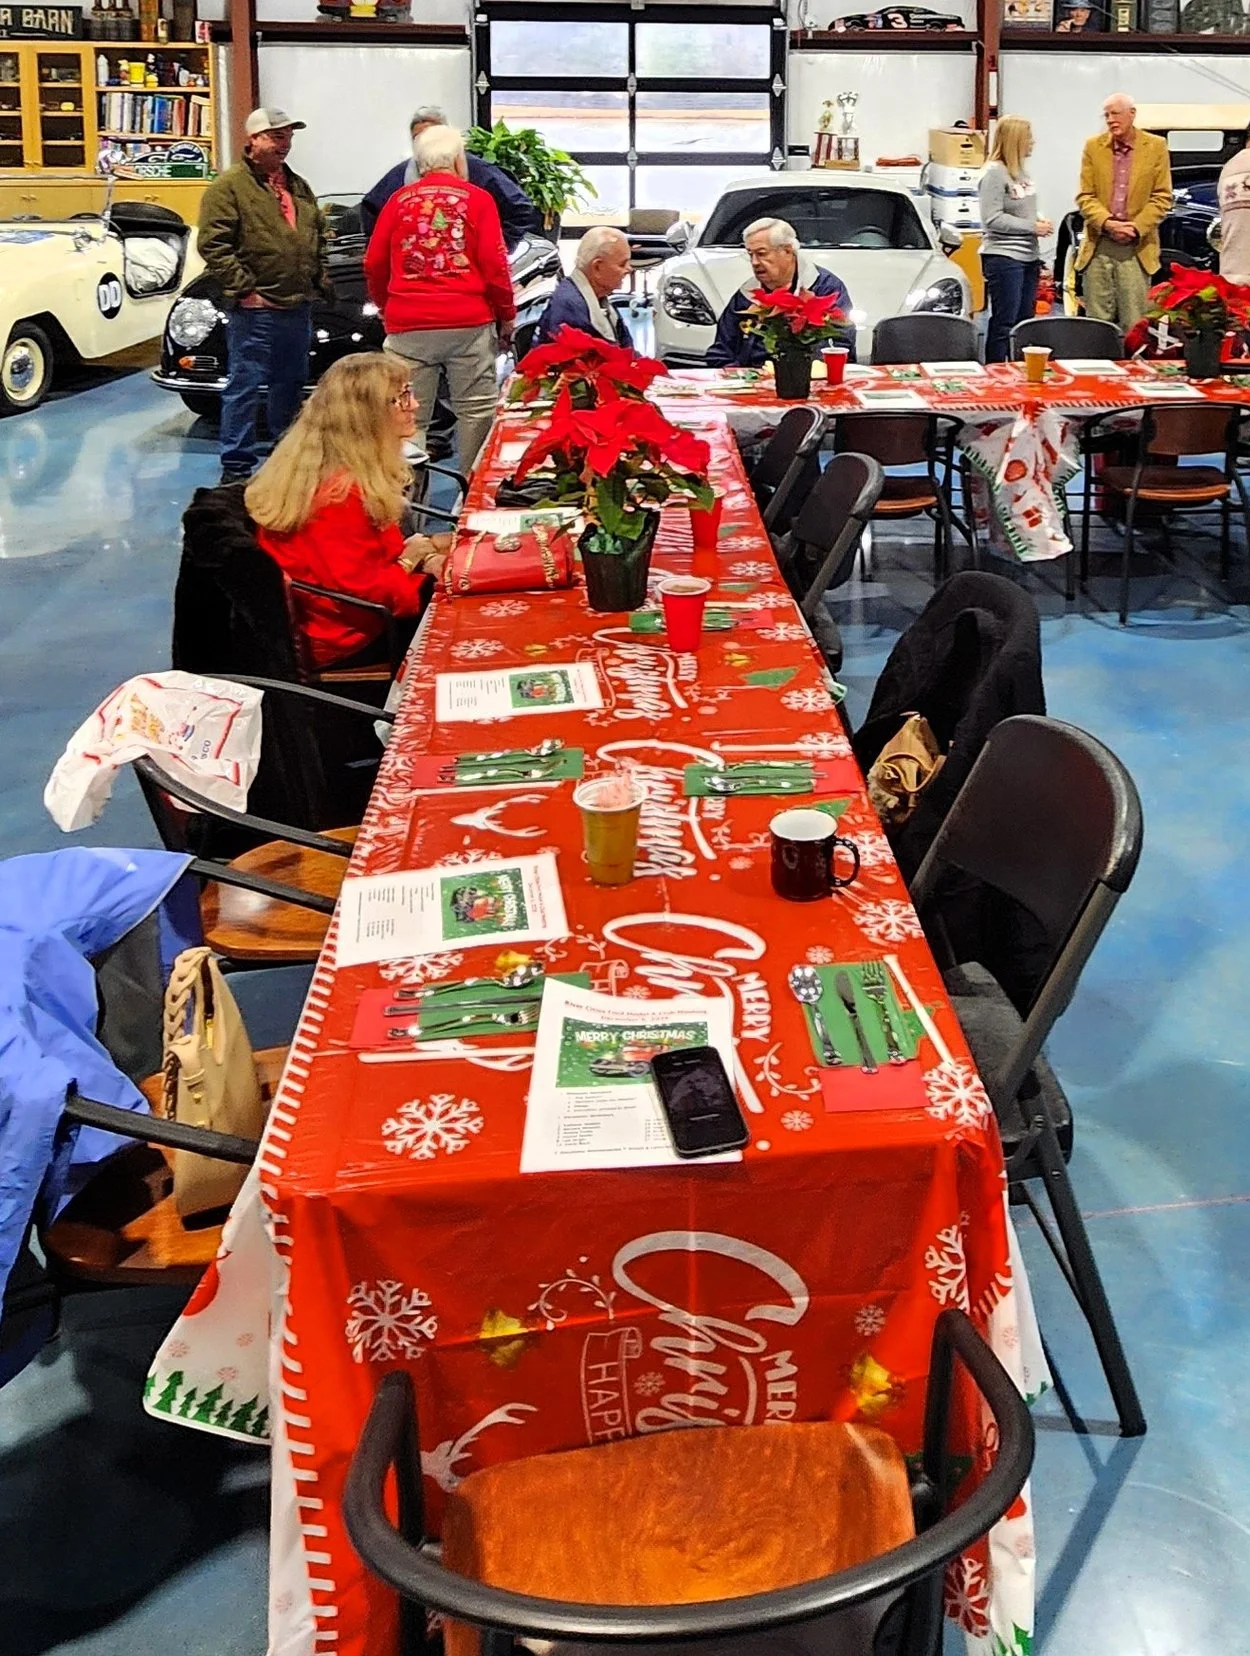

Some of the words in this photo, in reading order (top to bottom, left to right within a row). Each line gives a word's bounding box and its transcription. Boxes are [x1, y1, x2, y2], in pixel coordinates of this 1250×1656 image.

[22, 8, 74, 35] BARN
[887, 12, 908, 29] 3
[732, 971, 772, 1043] MERRY
[574, 1031, 617, 1043] MERRY
[622, 1029, 696, 1042] CHRISTMAS
